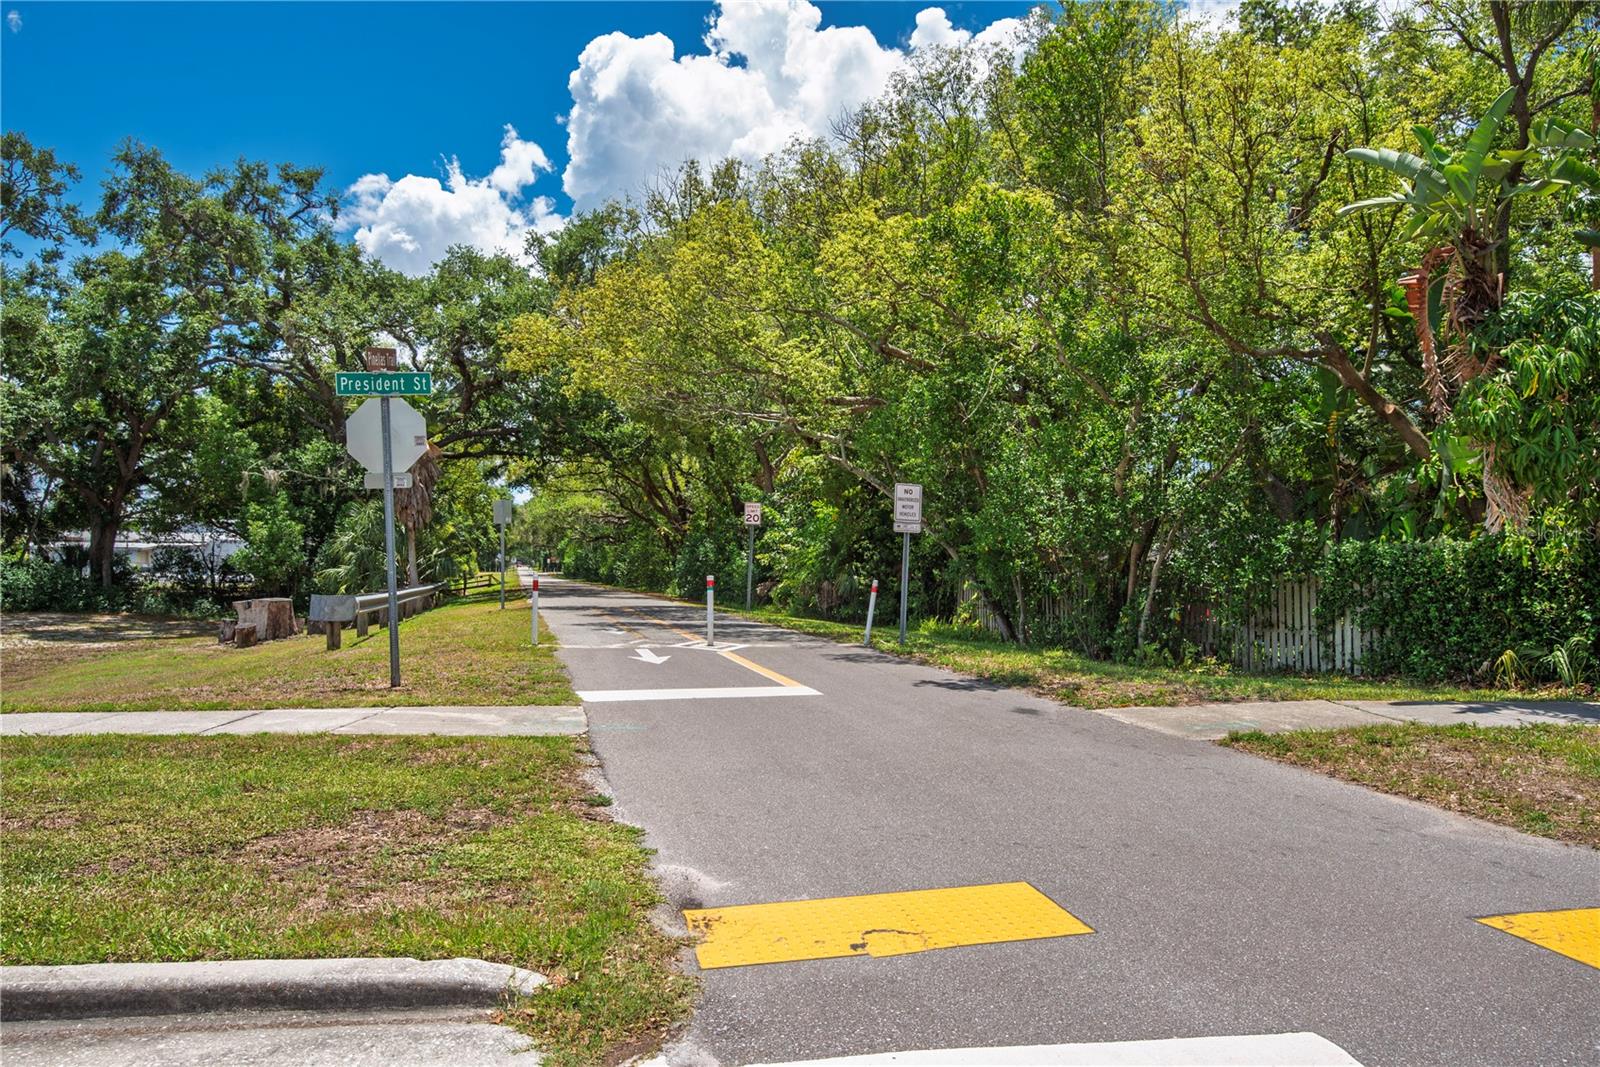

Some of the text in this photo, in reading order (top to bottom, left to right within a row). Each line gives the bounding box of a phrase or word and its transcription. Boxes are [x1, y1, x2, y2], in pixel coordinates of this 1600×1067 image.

[340, 376, 427, 391] President St
[746, 514, 760, 522] 20
